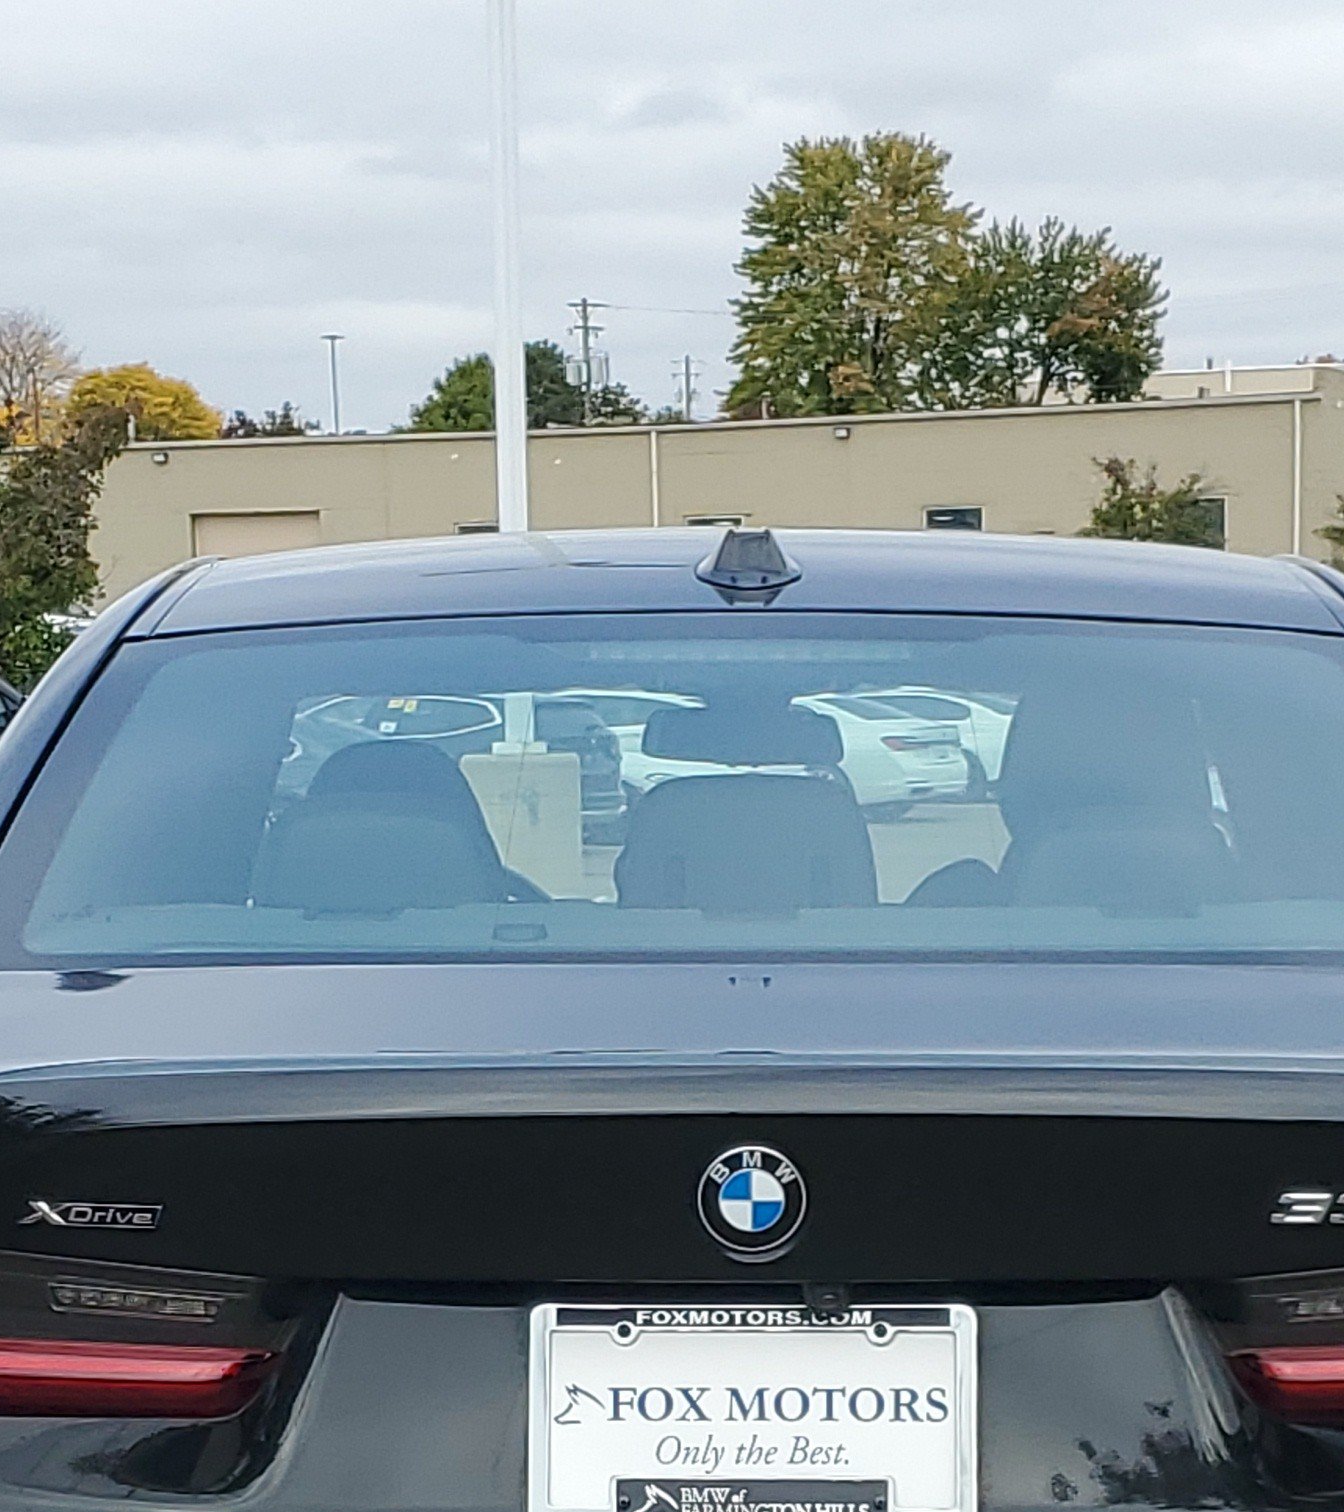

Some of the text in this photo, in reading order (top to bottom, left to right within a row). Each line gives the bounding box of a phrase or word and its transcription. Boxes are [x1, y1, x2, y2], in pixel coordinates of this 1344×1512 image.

[709, 1151, 796, 1185] BMW
[606, 1386, 950, 1423] FOX MOTORS
[655, 1434, 851, 1474] Only the Best.
[679, 1487, 748, 1503] BMW of
